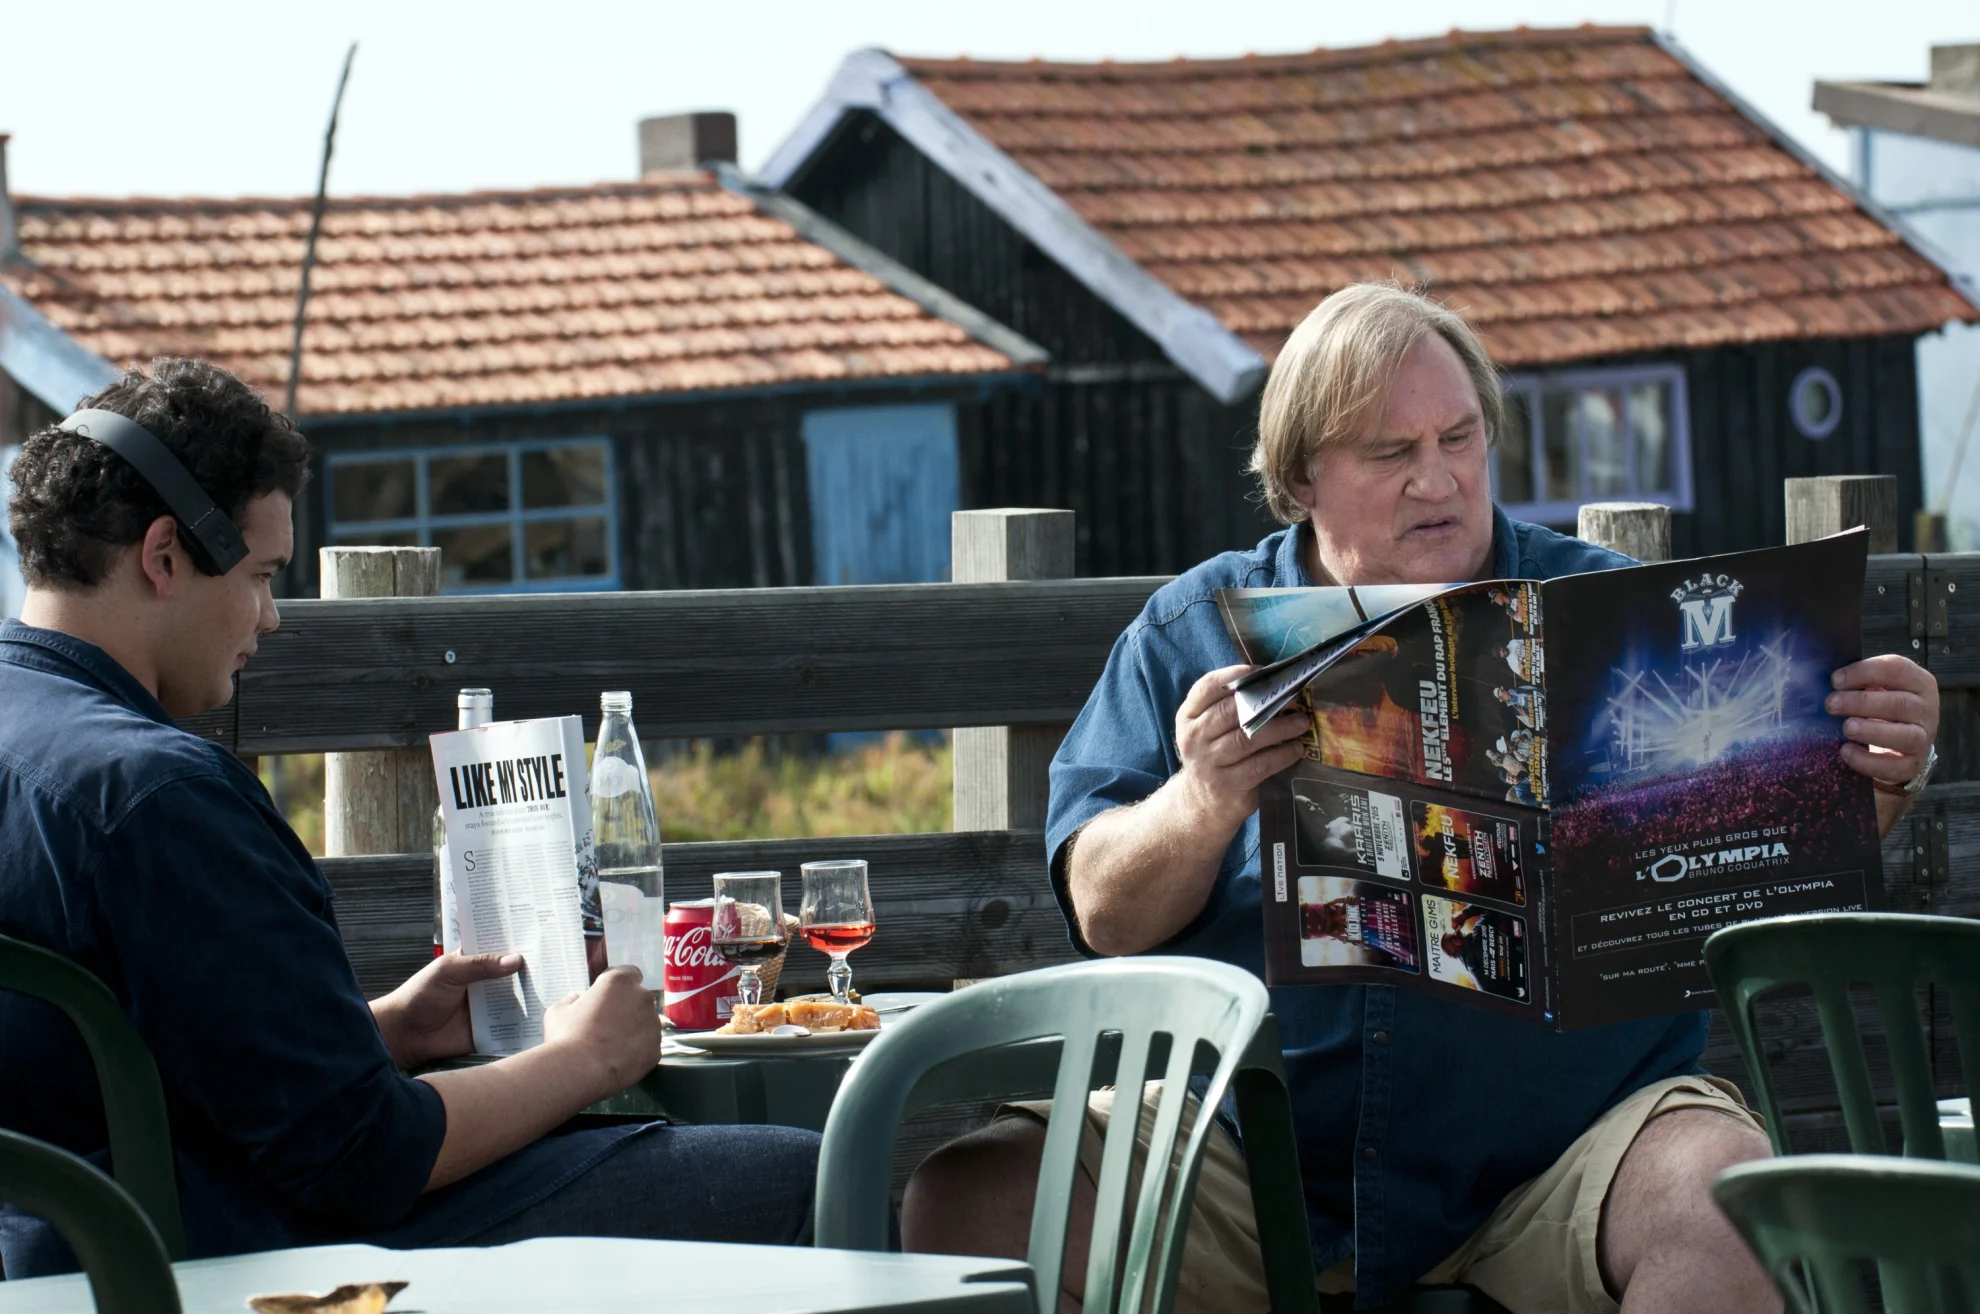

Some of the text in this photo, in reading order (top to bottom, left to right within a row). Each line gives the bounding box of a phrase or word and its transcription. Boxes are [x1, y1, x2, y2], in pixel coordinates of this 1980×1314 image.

[1670, 573, 1743, 603] BLACK
[1520, 584, 1528, 632] SOPRANO
[1679, 595, 1736, 650] M
[1434, 635, 1444, 660] RAP
[1436, 662, 1446, 681] DU
[1438, 683, 1450, 740] ELEMENT
[1450, 674, 1459, 719] L'interview
[1419, 680, 1442, 780] NEKFEU
[1528, 744, 1534, 754] M
[449, 753, 566, 810] LIKE MY STYLE
[1444, 767, 1452, 781] LE
[1360, 796, 1368, 810] AME
[1362, 812, 1370, 826] MON
[1371, 805, 1380, 821] 2015
[1351, 795, 1367, 864] KAARIS
[1364, 828, 1371, 836] DE
[1373, 822, 1384, 856] NOVEMBRE
[1382, 820, 1390, 850] ZENITH
[1635, 826, 1787, 860] LES YEUX PLUS GROS QUE
[1365, 839, 1374, 857] BRUIT
[1440, 814, 1460, 879] NEKFEU
[1475, 830, 1487, 877] ZENITH
[1636, 842, 1790, 883] L'OLYMPIA
[1688, 856, 1790, 879] BRUNO COQUATRIX
[1427, 900, 1438, 929] GIMS
[1600, 880, 1834, 923] REVIVEZ LE CONCERT DE L'OLYMPIA
[1669, 900, 1763, 922] EN CD ET DVD
[1346, 922, 1361, 940] KID
[1389, 904, 1401, 950] LA VILLETTE
[1591, 935, 1642, 950] DÉCOUVREZ
[1646, 931, 1670, 939] TOUS
[1692, 923, 1722, 932] TUBES
[1843, 904, 1862, 912] LIVE
